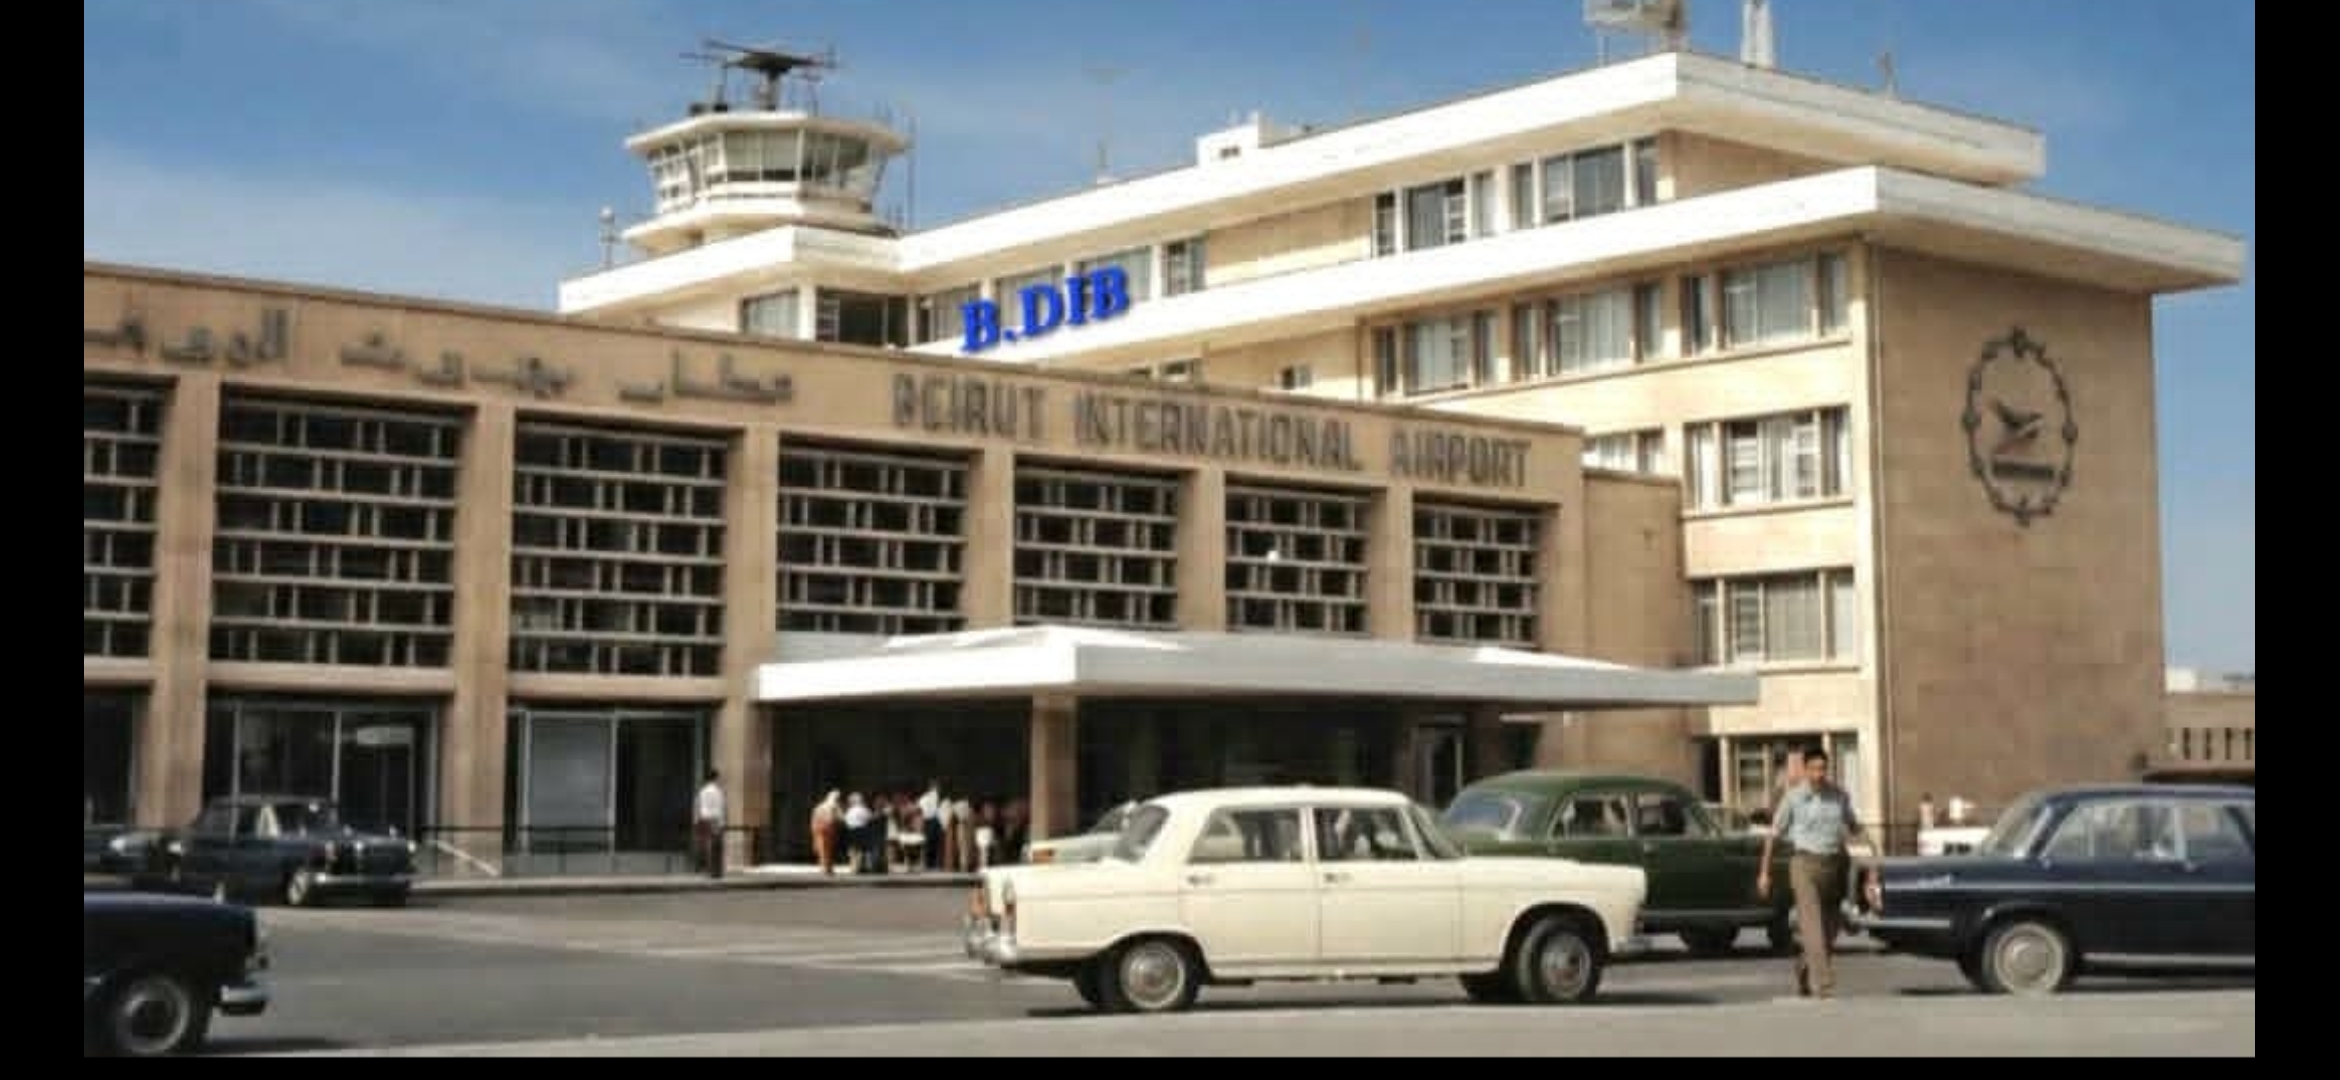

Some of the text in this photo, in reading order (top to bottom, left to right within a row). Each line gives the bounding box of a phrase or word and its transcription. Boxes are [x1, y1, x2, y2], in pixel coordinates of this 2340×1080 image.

[892, 372, 1533, 488] BEIRUT INTERNATIONAL AIRPORT
